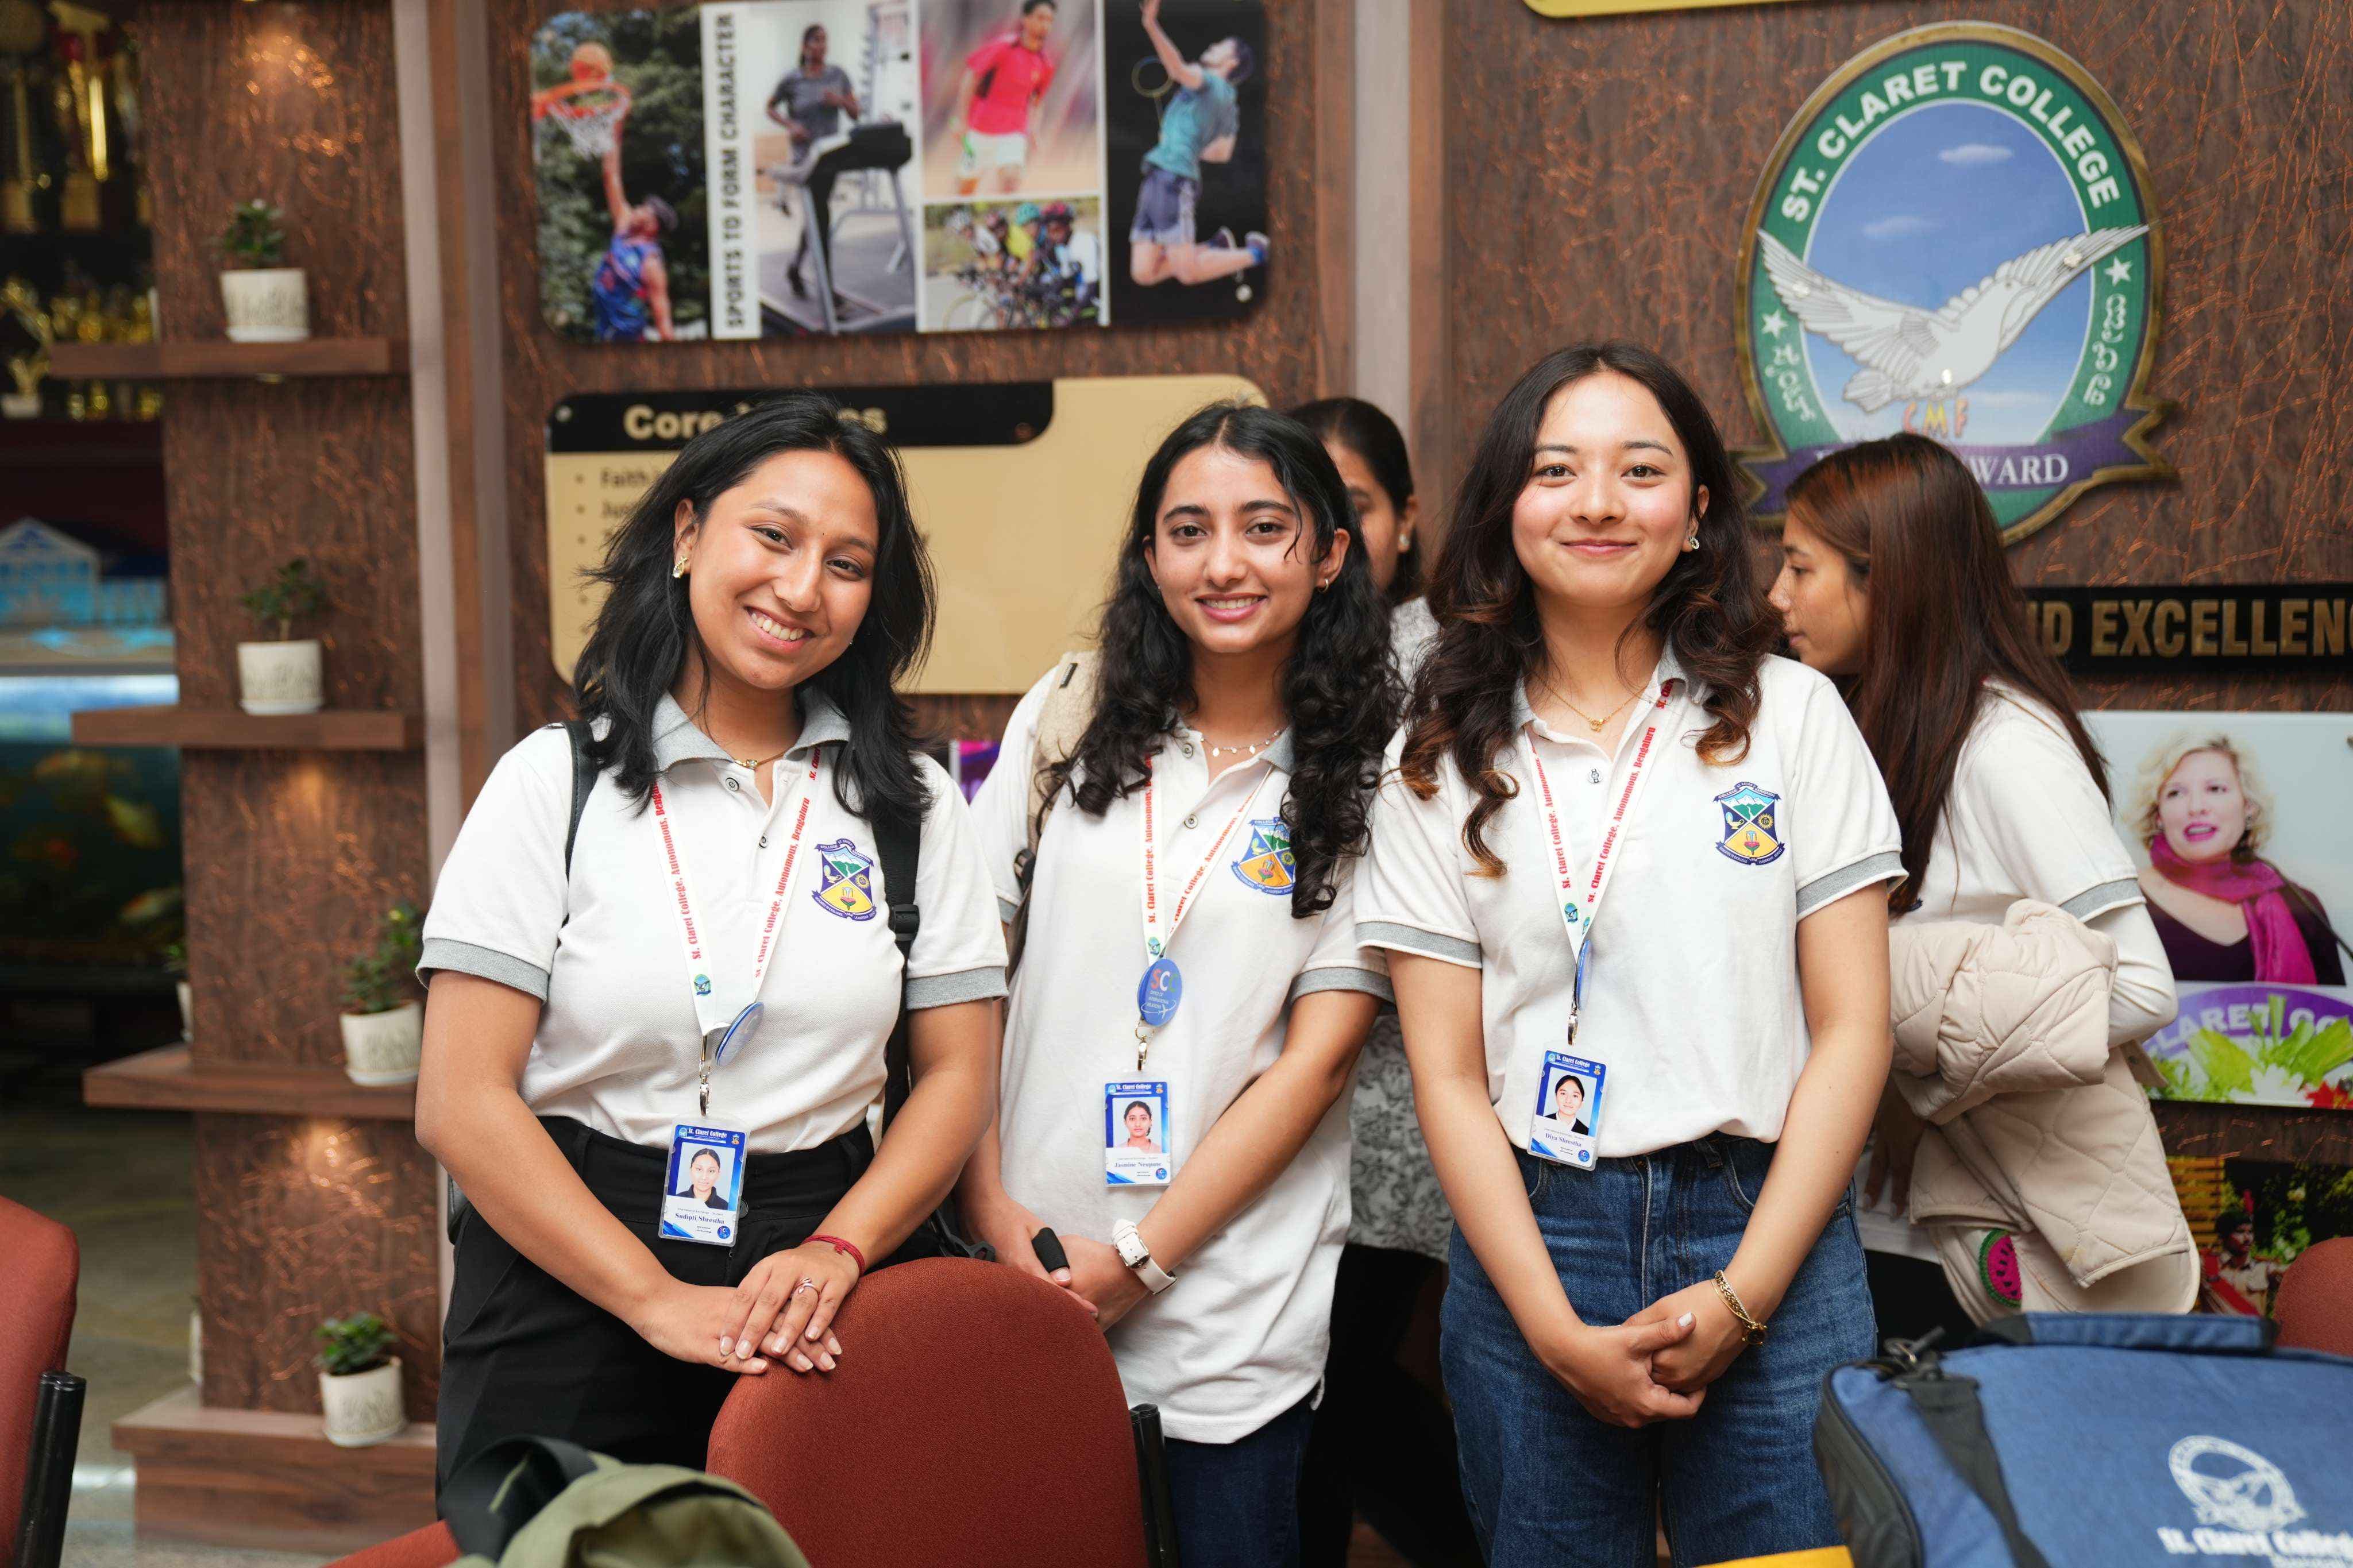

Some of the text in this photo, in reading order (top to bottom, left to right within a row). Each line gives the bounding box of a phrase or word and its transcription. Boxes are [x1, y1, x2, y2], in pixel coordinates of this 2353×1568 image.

[1781, 61, 2121, 222] ST. CLARET COLLEGE
[716, 13, 745, 328] SPORTS TO FORM CHARACTER
[623, 403, 723, 441] Core
[1969, 453, 2069, 486] WARD
[2091, 599, 2353, 658] EXCELLEN
[652, 780, 665, 816] Benga
[1591, 861, 1606, 889] Claret
[1633, 726, 1656, 768] Bengaluru
[1556, 846, 1569, 875] Claret
[757, 936, 770, 964] Claret
[791, 797, 810, 841] Bengaluru
[1147, 883, 1156, 910] Claret
[683, 917, 697, 945] Claret
[1150, 968, 1179, 992] SCC
[2149, 1003, 2270, 1049] LARET
[675, 1212, 724, 1225] Sudipti Shrestha
